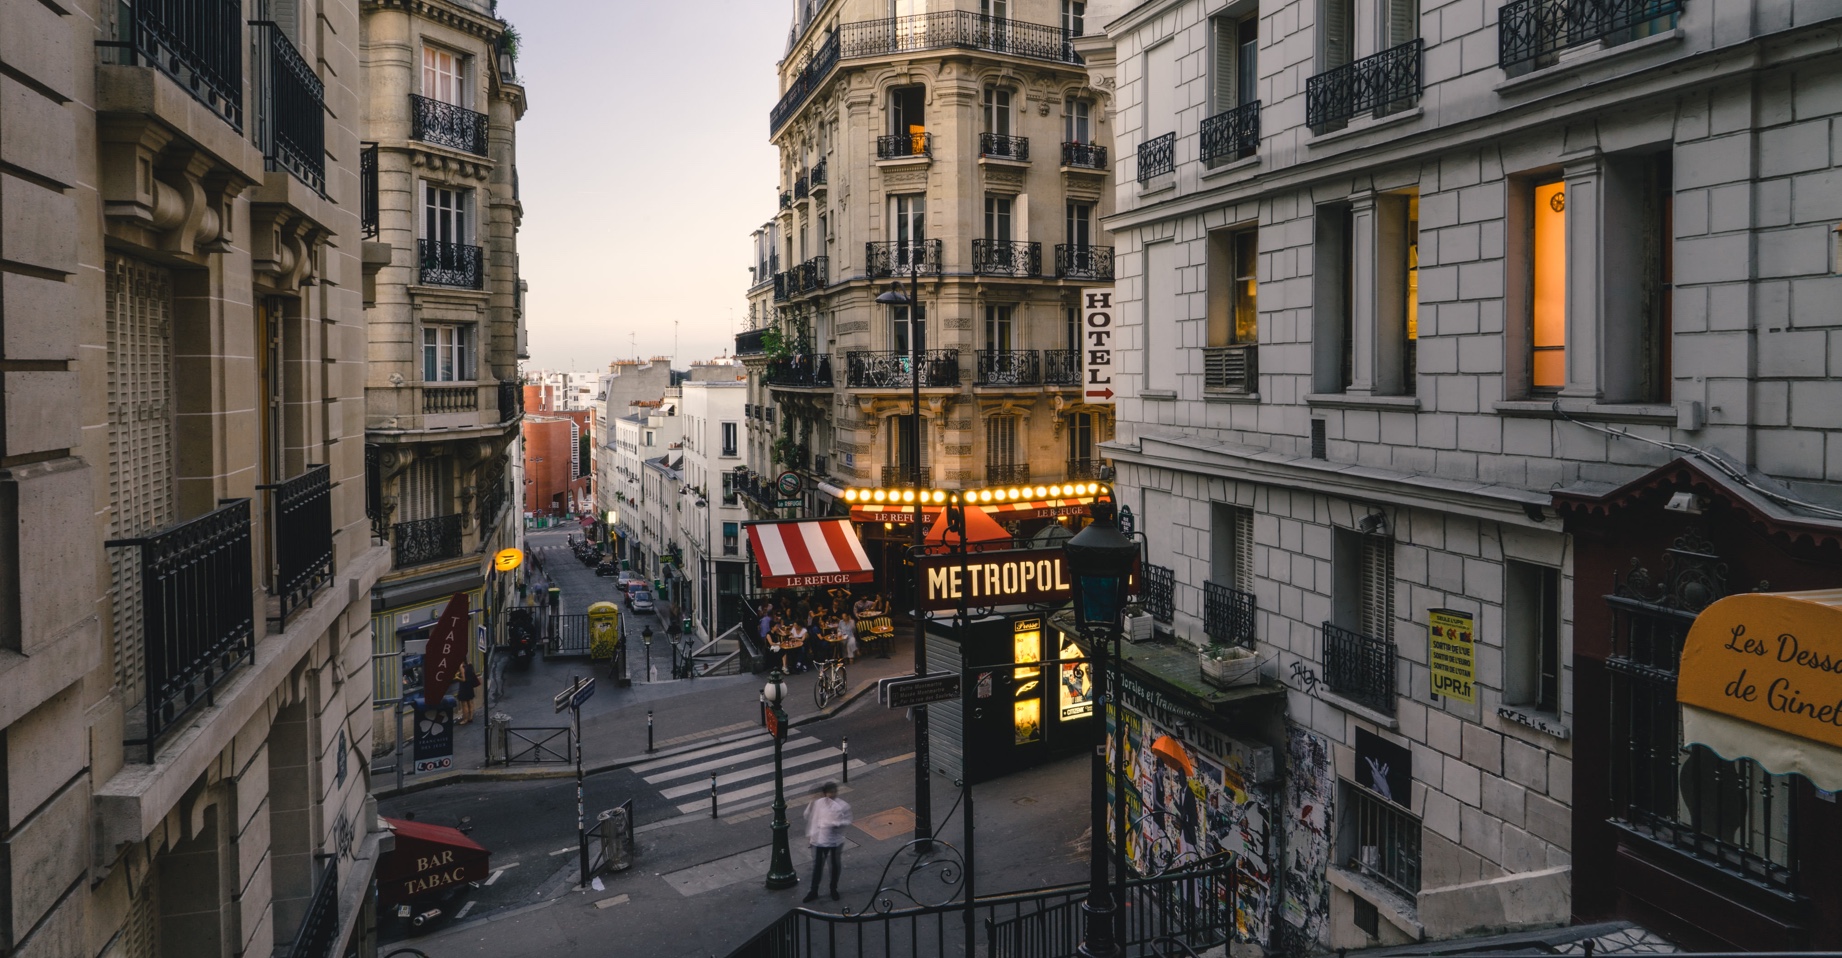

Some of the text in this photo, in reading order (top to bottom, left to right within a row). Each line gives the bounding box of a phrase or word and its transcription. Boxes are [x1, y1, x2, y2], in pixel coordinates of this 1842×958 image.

[1086, 293, 1112, 384] HOTEL
[875, 513, 930, 522] LE REFUE
[1037, 510, 1048, 518] LE
[787, 574, 850, 586] LE REFUGE
[928, 558, 1133, 600] METROPOL
[435, 616, 460, 682] TABAC
[1433, 640, 1451, 650] SORTIR
[1452, 644, 1458, 653] DE
[1724, 624, 1768, 656] Les
[1433, 652, 1448, 660] SORTIR
[1433, 662, 1449, 671] SORTIR
[1450, 666, 1455, 674] DE
[1121, 674, 1144, 698] lorales
[1146, 691, 1154, 703] et
[1725, 669, 1758, 702] de
[417, 758, 451, 771] LOTO
[417, 850, 454, 872] BAR
[404, 867, 465, 894] TABAC
